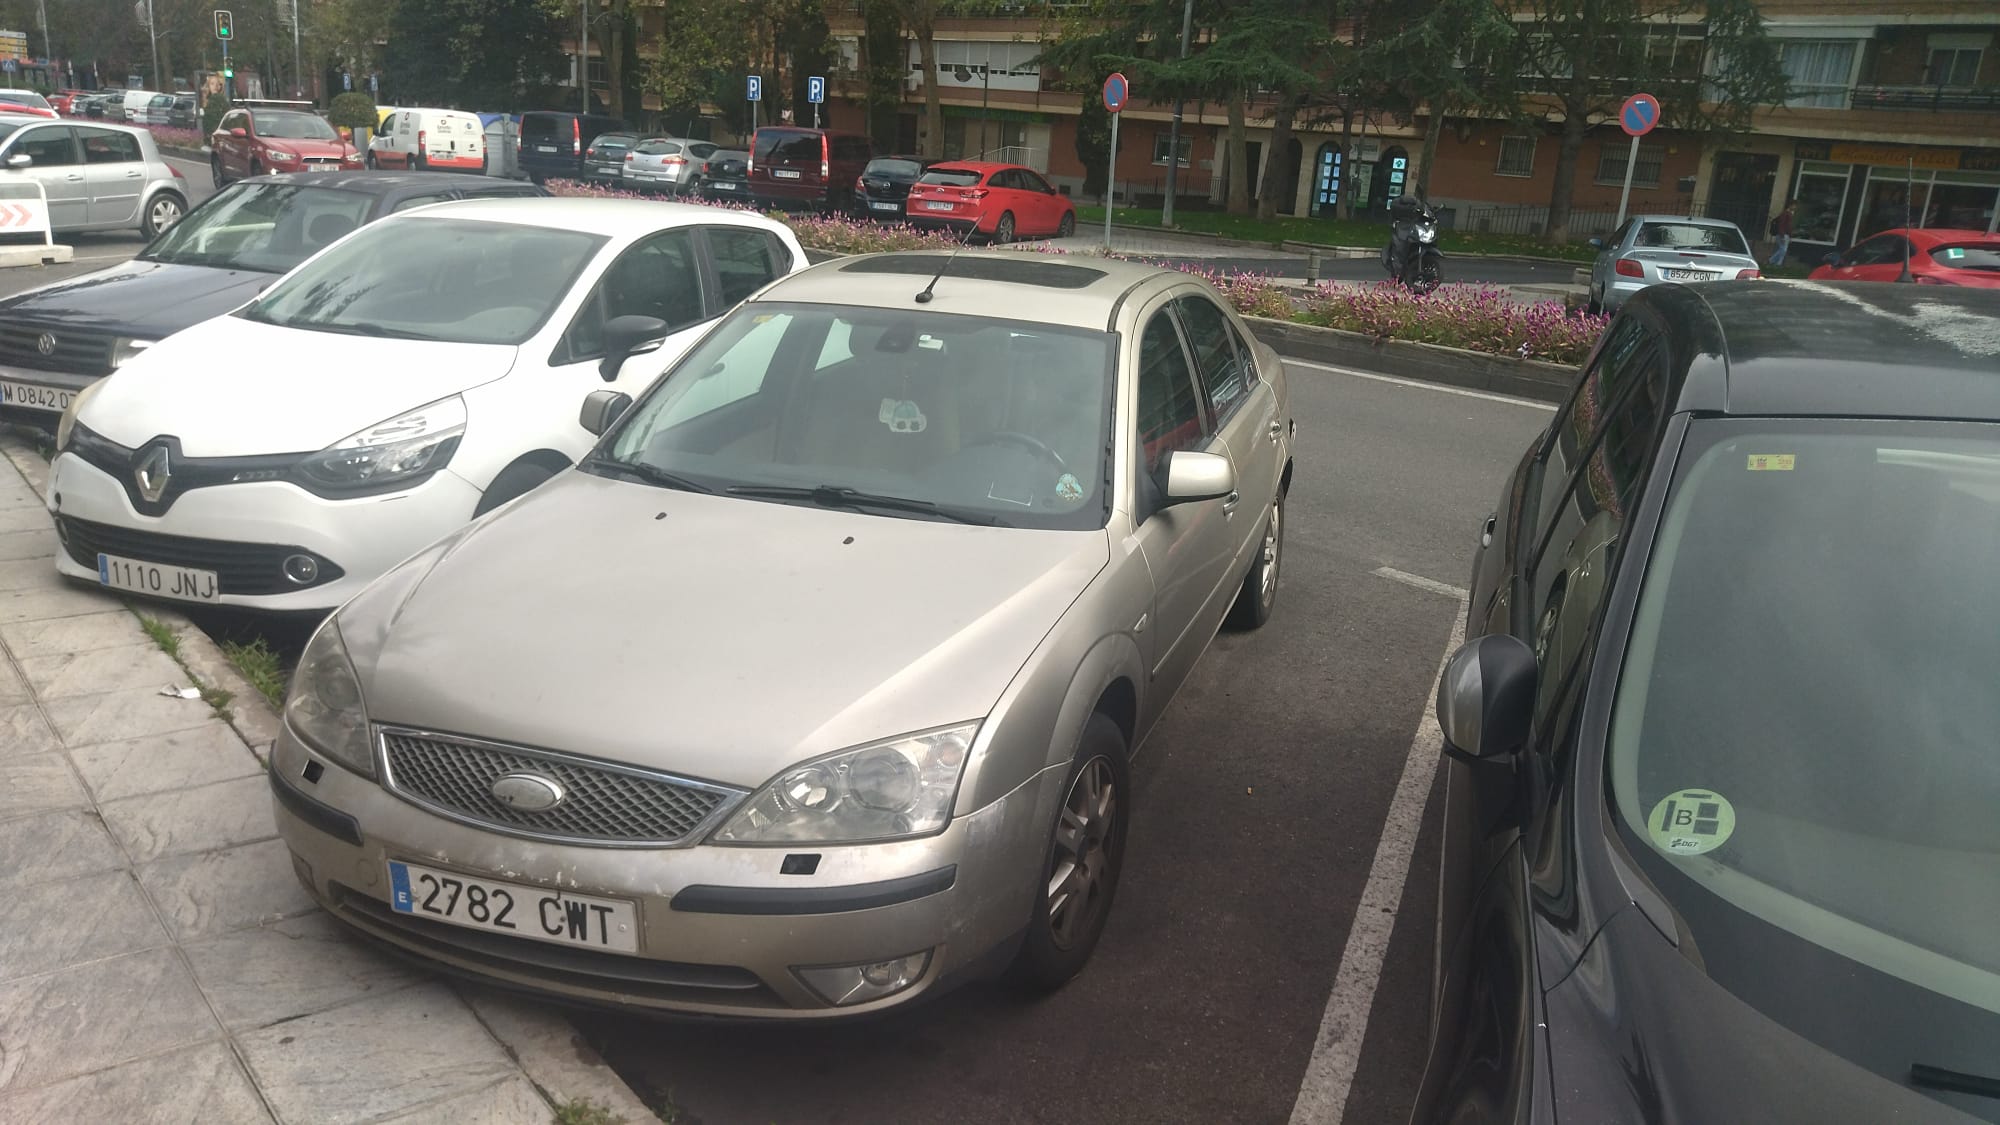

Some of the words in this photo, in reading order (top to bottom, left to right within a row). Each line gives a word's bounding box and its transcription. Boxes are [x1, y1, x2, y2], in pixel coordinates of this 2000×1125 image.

[749, 79, 757, 97] P
[811, 80, 820, 100] P
[1670, 270, 1691, 280] 8527
[1693, 271, 1711, 281] CGN
[3, 383, 13, 402] M
[17, 386, 56, 408] 0842
[112, 561, 161, 591] 1110
[170, 571, 214, 599] JNJ
[1675, 809, 1693, 826] B
[398, 891, 407, 904] E
[419, 873, 516, 929] 2782
[538, 896, 614, 945] CWT
